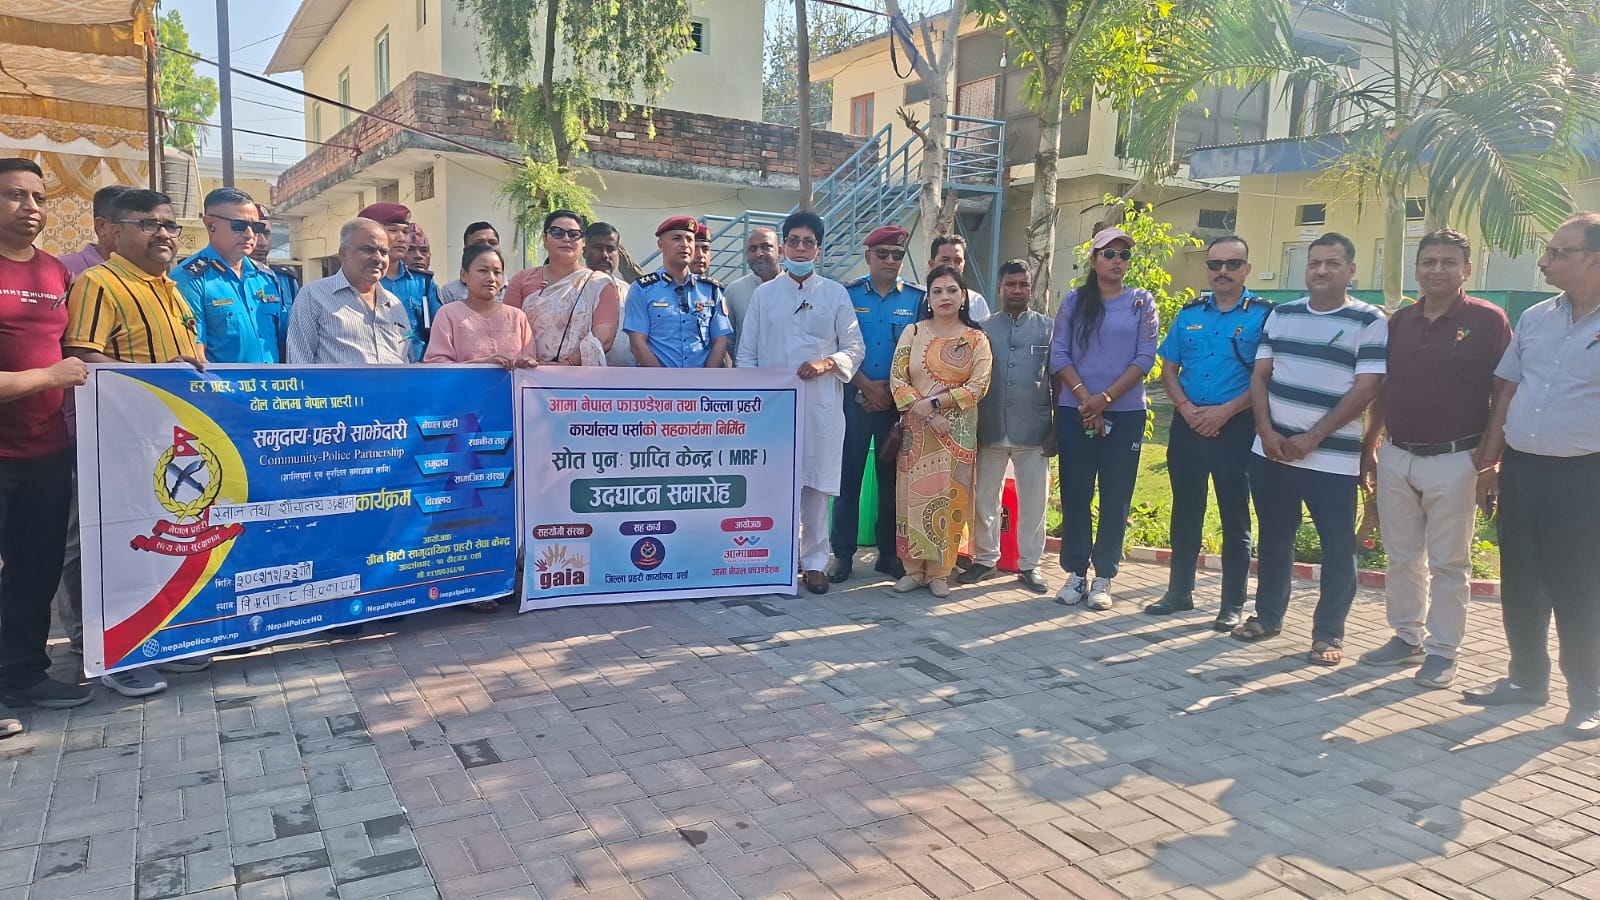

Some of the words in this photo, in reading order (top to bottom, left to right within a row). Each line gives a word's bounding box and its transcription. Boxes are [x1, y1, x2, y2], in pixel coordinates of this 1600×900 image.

[189, 380, 205, 392] हर
[259, 380, 268, 391] र
[250, 396, 268, 411] टोल
[272, 396, 302, 410] टोलमा
[304, 395, 328, 409] नेपाल
[549, 397, 577, 413] आमा
[581, 393, 613, 413] नेपाल
[616, 393, 673, 413] फाउण्डेशन
[676, 397, 697, 413] तथा
[700, 395, 733, 413] जिल्ला
[736, 396, 762, 413] प्रहरी
[351, 418, 408, 443] साझेदारी
[422, 420, 440, 429] नेपाल
[442, 418, 458, 429] प्रहरी
[570, 421, 619, 438] कार्यालय
[622, 420, 657, 438] पर्साको
[661, 420, 712, 437] सहकार्यमा
[716, 419, 746, 436] निर्मित
[354, 447, 405, 461] Partnership
[552, 446, 585, 471] स्रोत
[630, 445, 670, 470] प्राप्ति
[676, 445, 713, 469] केन्द्र
[729, 449, 758, 466] MRF
[424, 458, 449, 469] समुदाय
[454, 473, 484, 483] सामाजिक
[667, 477, 732, 505] समारोह
[356, 487, 412, 511] कार्यक्रम
[248, 503, 274, 518] तथा
[168, 525, 189, 535] नेपाल
[190, 520, 208, 534] प्रहरी
[537, 526, 565, 536] सहयोगी
[566, 526, 585, 536] संस्था
[735, 519, 762, 529] आयोजक
[156, 541, 173, 552] सत्य
[175, 544, 188, 553] सेवा
[365, 553, 384, 566] ग्रीन
[385, 549, 406, 562] सिटी
[407, 543, 451, 559] सामुदायिक
[453, 540, 473, 552] प्रहरी
[475, 538, 489, 549] सेवा
[491, 536, 510, 547] केन्द्र
[604, 573, 626, 584] जिल्ला
[628, 572, 644, 583] प्रहरी
[676, 570, 689, 579] पर्सा
[729, 566, 746, 575] नेपाल
[540, 568, 585, 590] gaia
